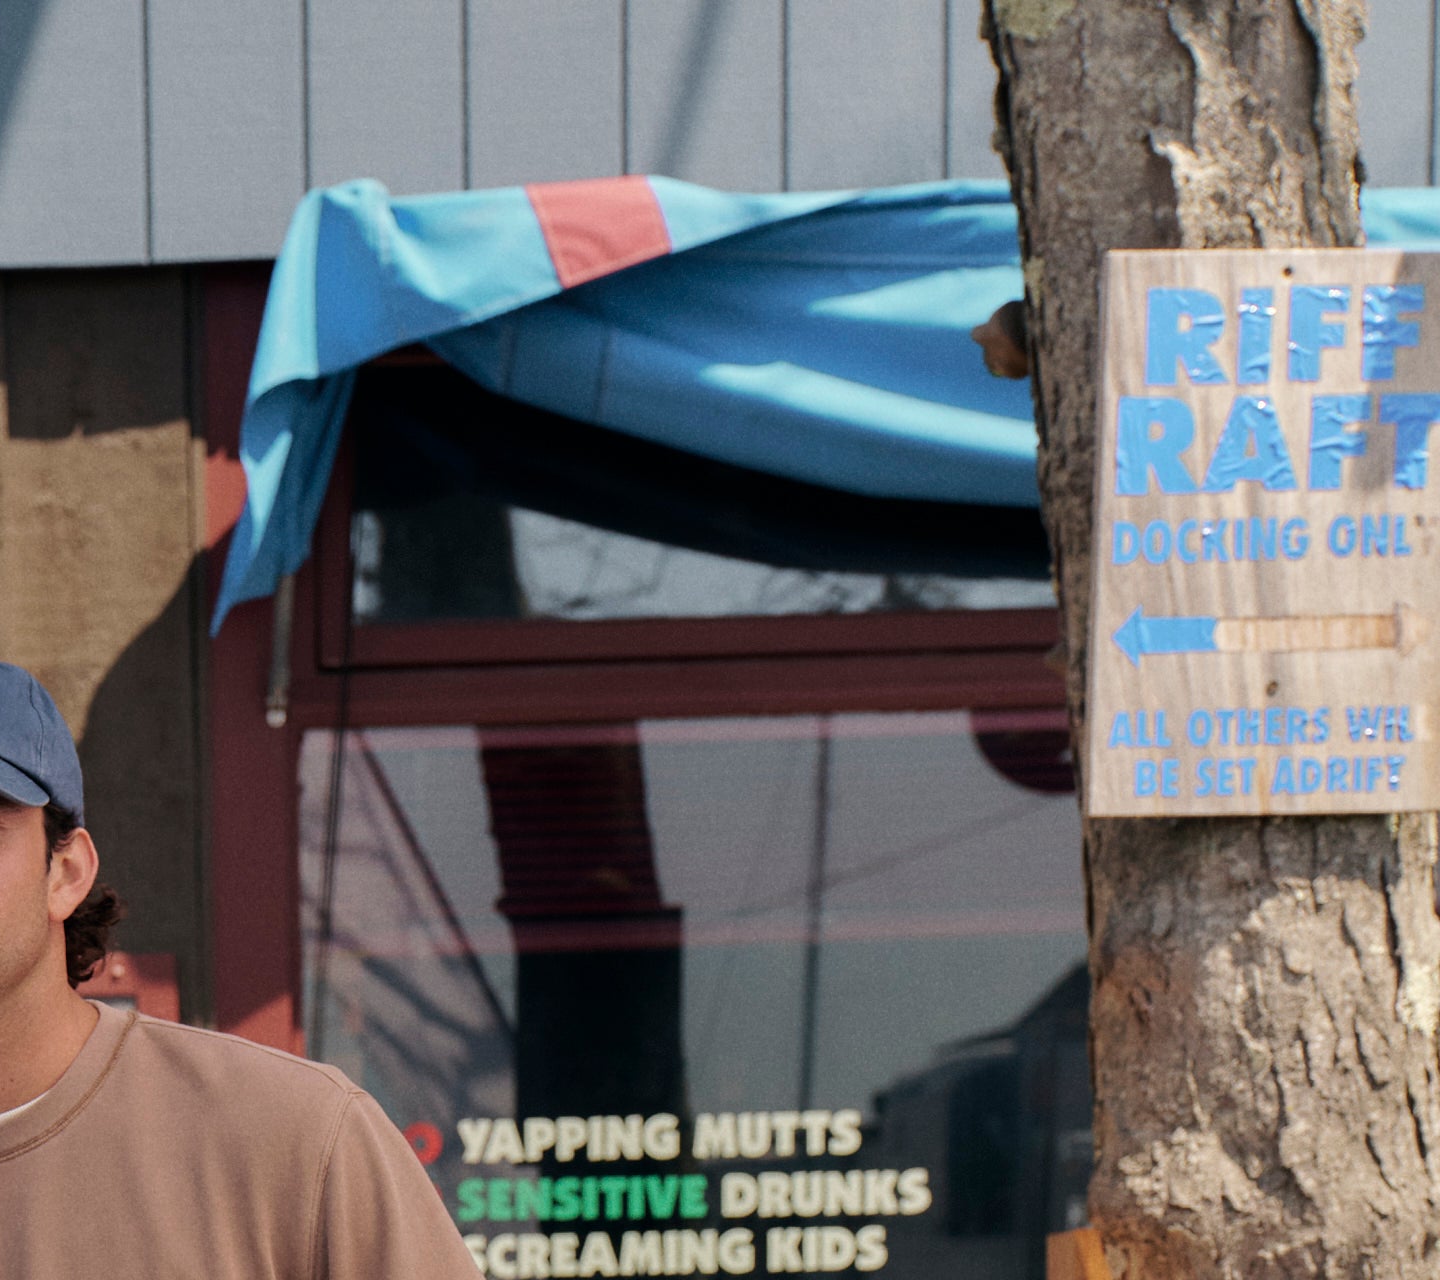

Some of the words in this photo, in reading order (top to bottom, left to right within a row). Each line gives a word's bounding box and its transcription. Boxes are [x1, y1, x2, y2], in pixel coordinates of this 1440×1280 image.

[1145, 284, 1425, 386] RIFF
[1115, 393, 1440, 496] RAFT
[1112, 516, 1308, 566] DOCKING
[1110, 709, 1172, 747] ALL
[1187, 706, 1330, 746] OTHERS
[1134, 758, 1180, 798] BE
[1194, 757, 1257, 797] SET
[1271, 755, 1406, 795] ADRIFT
[457, 1113, 681, 1165] YAPPING
[692, 1108, 863, 1160] MUTTS
[457, 1174, 709, 1222] SENSITIVE
[720, 1167, 933, 1219] DRUNKS
[462, 1226, 756, 1280] SCREAMING
[766, 1224, 889, 1274] KIDS
